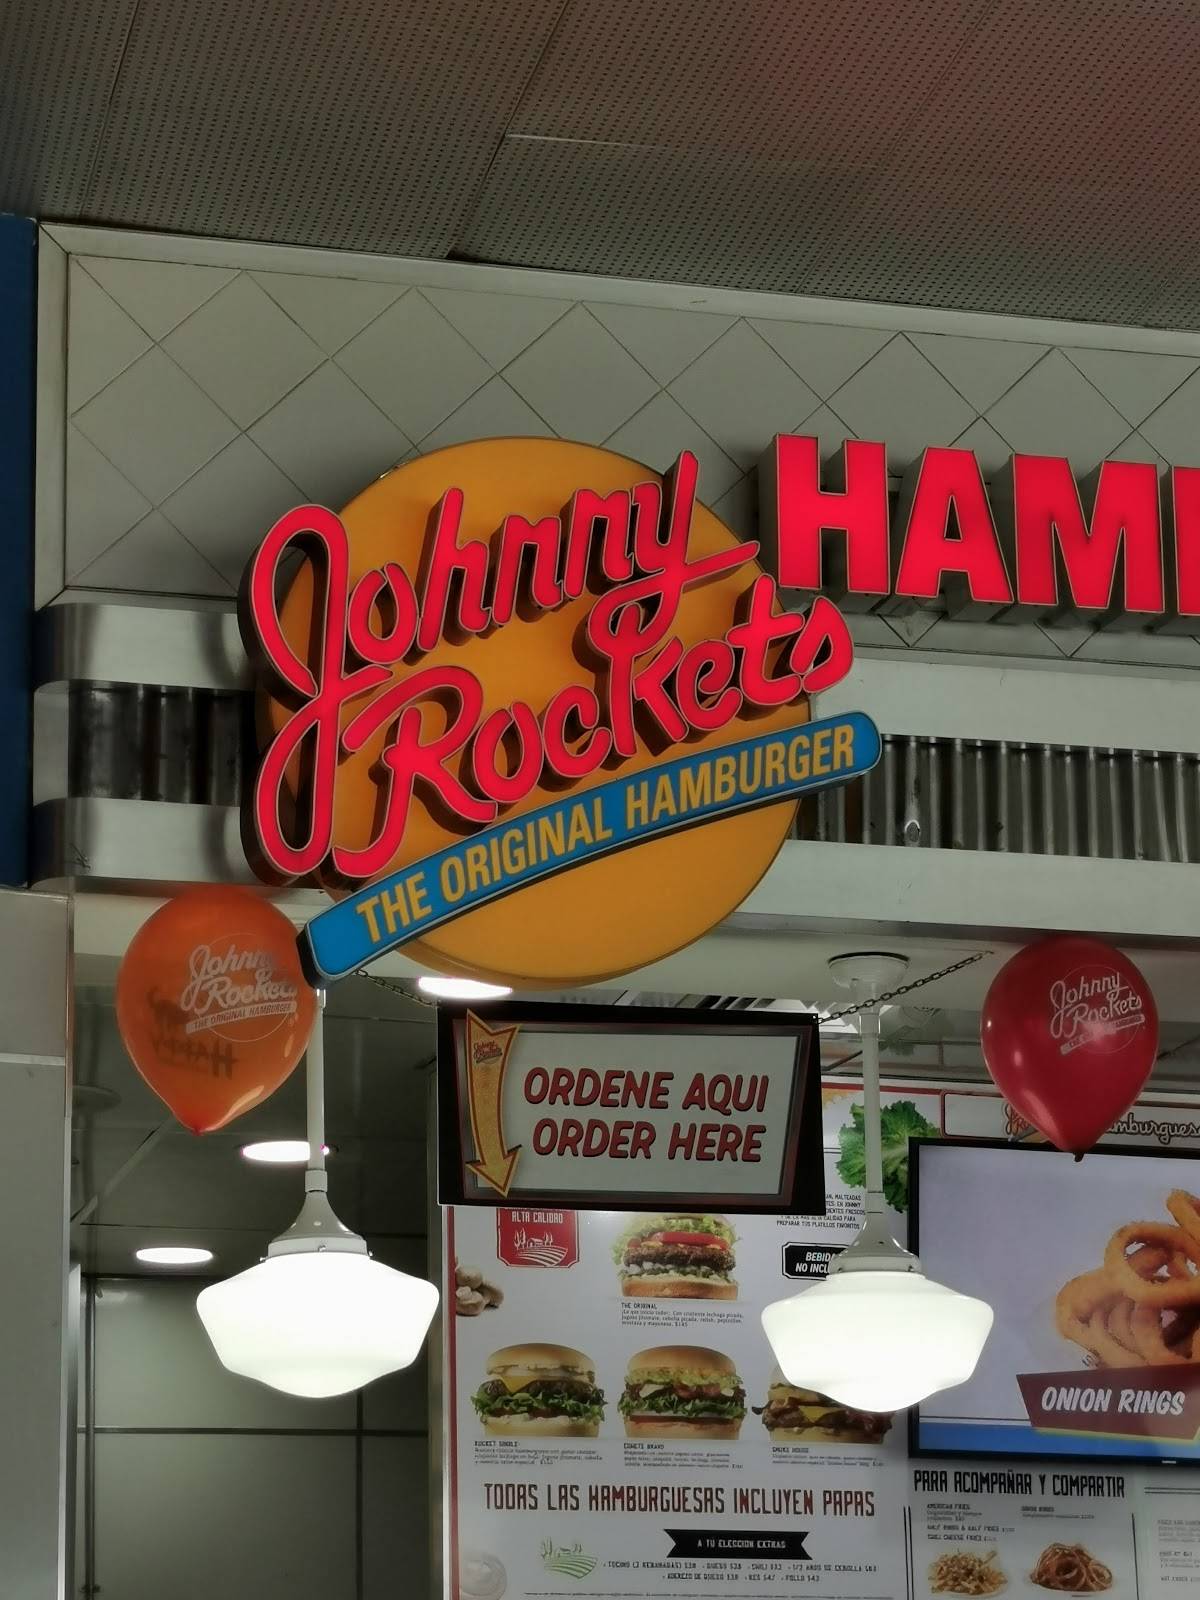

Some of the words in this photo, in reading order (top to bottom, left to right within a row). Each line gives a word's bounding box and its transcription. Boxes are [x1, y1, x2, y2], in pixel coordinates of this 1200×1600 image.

[777, 433, 1200, 617] HAM
[250, 450, 760, 876] Johnny
[333, 574, 853, 878] Rockets
[357, 871, 432, 944] THE
[440, 797, 612, 903] ORIGINAL
[625, 724, 856, 829] HAMBURGER
[1051, 972, 1129, 1038] Johnny
[1062, 991, 1142, 1038] Rockets
[524, 1067, 674, 1110] ORDENE
[682, 1073, 770, 1116] AQUI
[532, 1118, 656, 1160] ORDER
[667, 1122, 767, 1162] HERE
[512, 1211, 530, 1223] ALTA
[533, 1212, 564, 1224] CALIDAD
[796, 1263, 808, 1272] NO
[1041, 1386, 1112, 1413] ONION
[1117, 1388, 1186, 1416] RINGS
[484, 1483, 538, 1510] TODAS
[548, 1485, 579, 1511] LAS
[589, 1486, 725, 1513] HAMBURGUESAS
[734, 1488, 814, 1515] INCLUYEN
[823, 1490, 875, 1516] PAPAS
[914, 1470, 948, 1492] PARA
[954, 1469, 1032, 1495] ACOMPAÑAR
[1039, 1474, 1046, 1495] Y
[1053, 1474, 1125, 1498] COMPARTIR
[697, 1539, 702, 1548] A
[706, 1539, 715, 1548] TU
